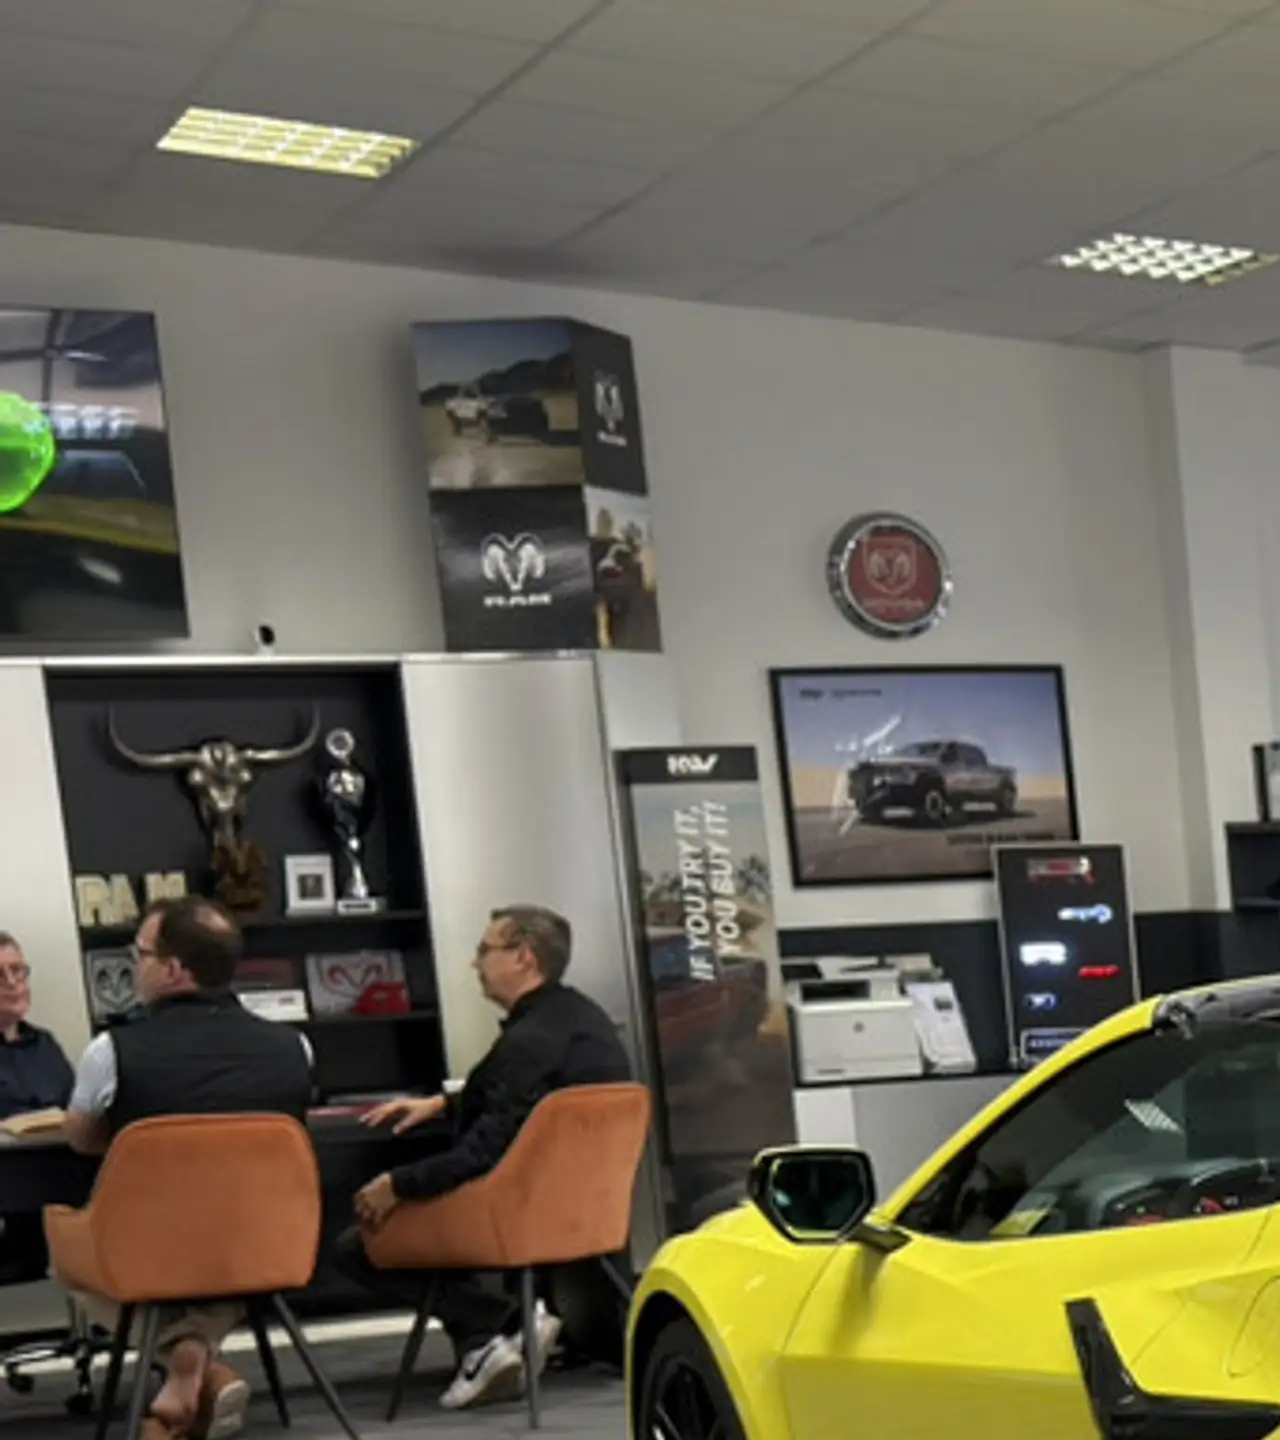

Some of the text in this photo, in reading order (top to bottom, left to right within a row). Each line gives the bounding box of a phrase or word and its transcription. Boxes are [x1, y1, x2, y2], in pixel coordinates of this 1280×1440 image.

[676, 839, 708, 890] TRY
[706, 839, 737, 895] BUY
[74, 868, 189, 927] RAM
[683, 894, 712, 951] YOU
[712, 898, 742, 957] YOU
[689, 955, 716, 982] IF
